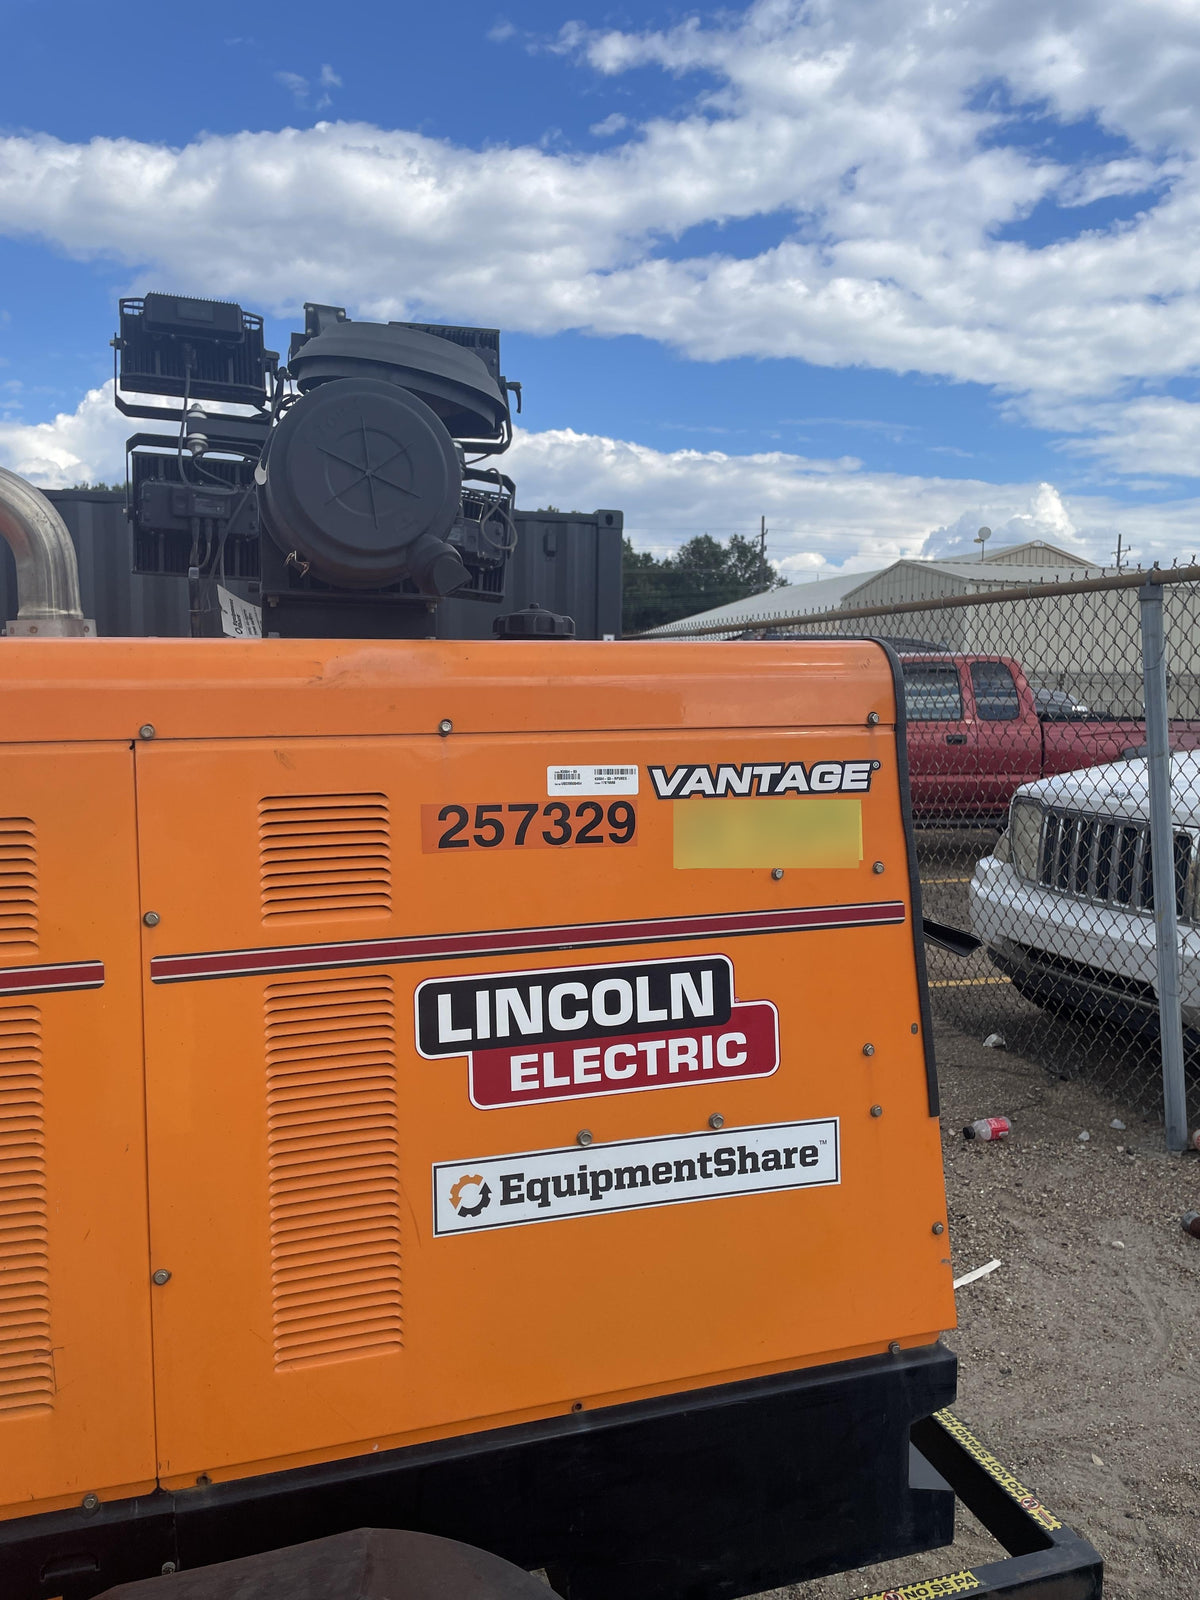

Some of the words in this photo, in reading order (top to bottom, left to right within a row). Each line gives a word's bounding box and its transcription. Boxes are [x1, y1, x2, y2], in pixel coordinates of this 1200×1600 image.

[437, 801, 636, 849] 257329
[437, 970, 715, 1044] LINCOLN
[510, 1031, 749, 1092] ELECTRIC
[954, 1428, 990, 1459] STAND
[985, 1460, 1011, 1481] NOT
[1007, 1481, 1027, 1497] DO
[903, 1587, 929, 1600] NO
[930, 1581, 954, 1593] SE
[955, 1575, 977, 1588] PA
